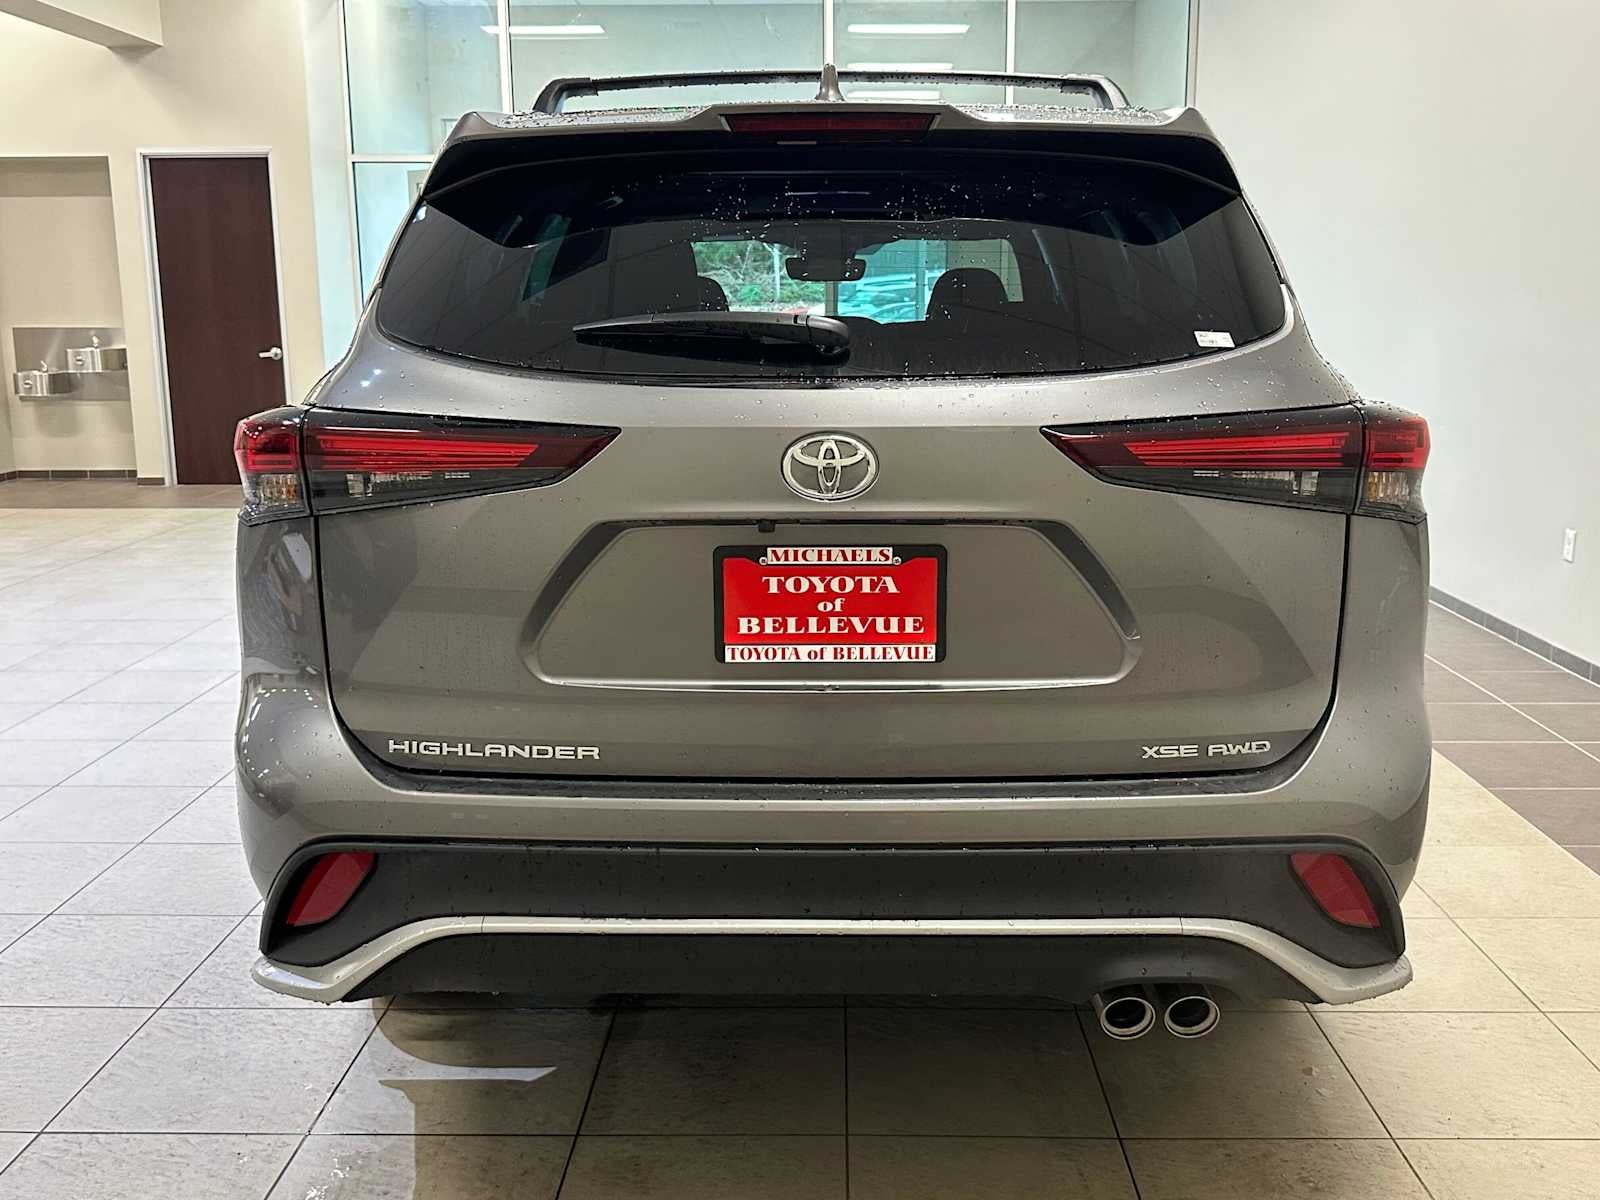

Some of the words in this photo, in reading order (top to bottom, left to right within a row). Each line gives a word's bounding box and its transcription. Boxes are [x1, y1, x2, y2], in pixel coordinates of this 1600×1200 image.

[769, 548, 891, 562] MICHAELS
[762, 576, 900, 593] TOYOTA
[817, 598, 846, 612] of
[737, 616, 925, 634] BELLEVUE
[727, 647, 801, 661] TOYOTA
[807, 646, 828, 661] of
[833, 646, 934, 661] BELLEVUE
[388, 739, 600, 759] HIGHLANDER
[1141, 744, 1199, 759] XSE
[1207, 740, 1272, 757] AWD
